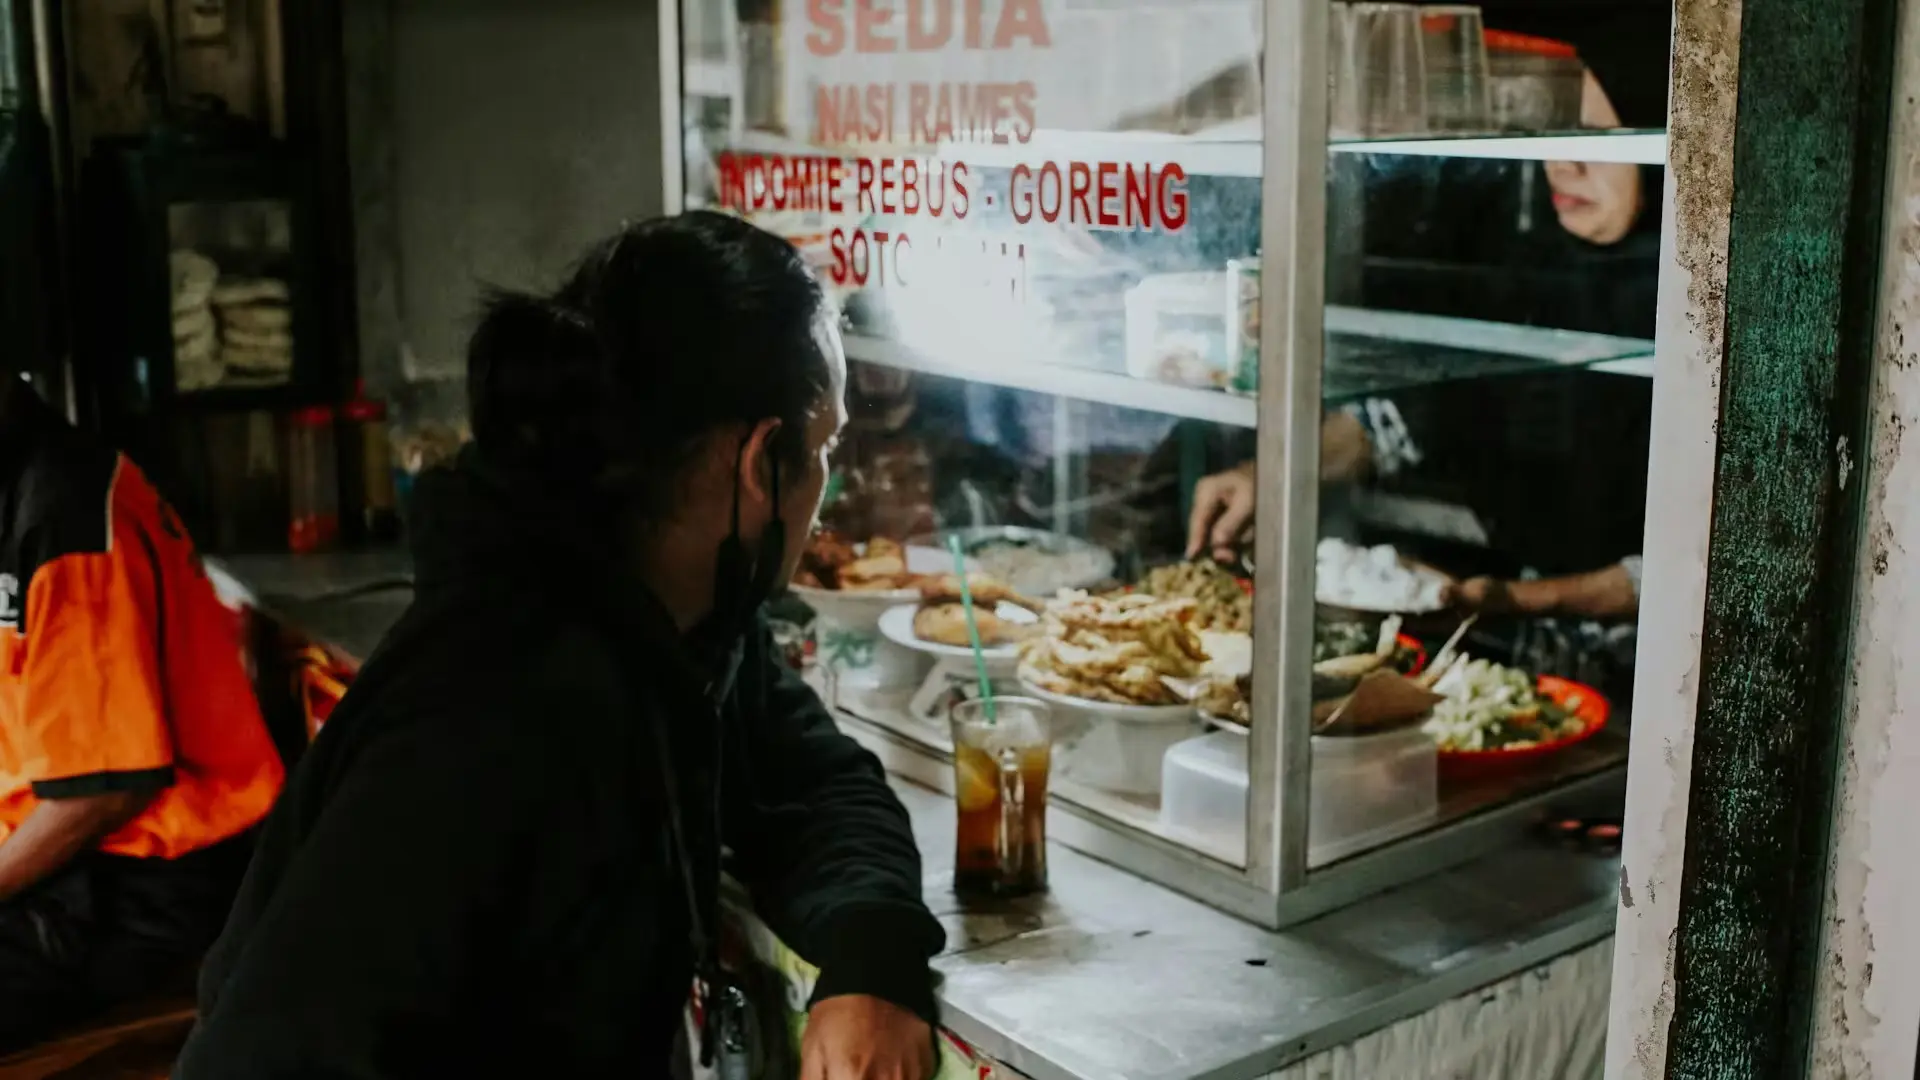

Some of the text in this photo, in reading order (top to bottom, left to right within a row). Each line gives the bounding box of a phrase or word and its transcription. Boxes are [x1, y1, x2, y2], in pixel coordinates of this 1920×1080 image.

[805, 0, 1052, 57] SEDIA
[816, 81, 1037, 144] NASI RAMES
[719, 151, 844, 214] INDOMIE
[857, 157, 969, 219] REBUS
[1010, 160, 1188, 231] GORENG
